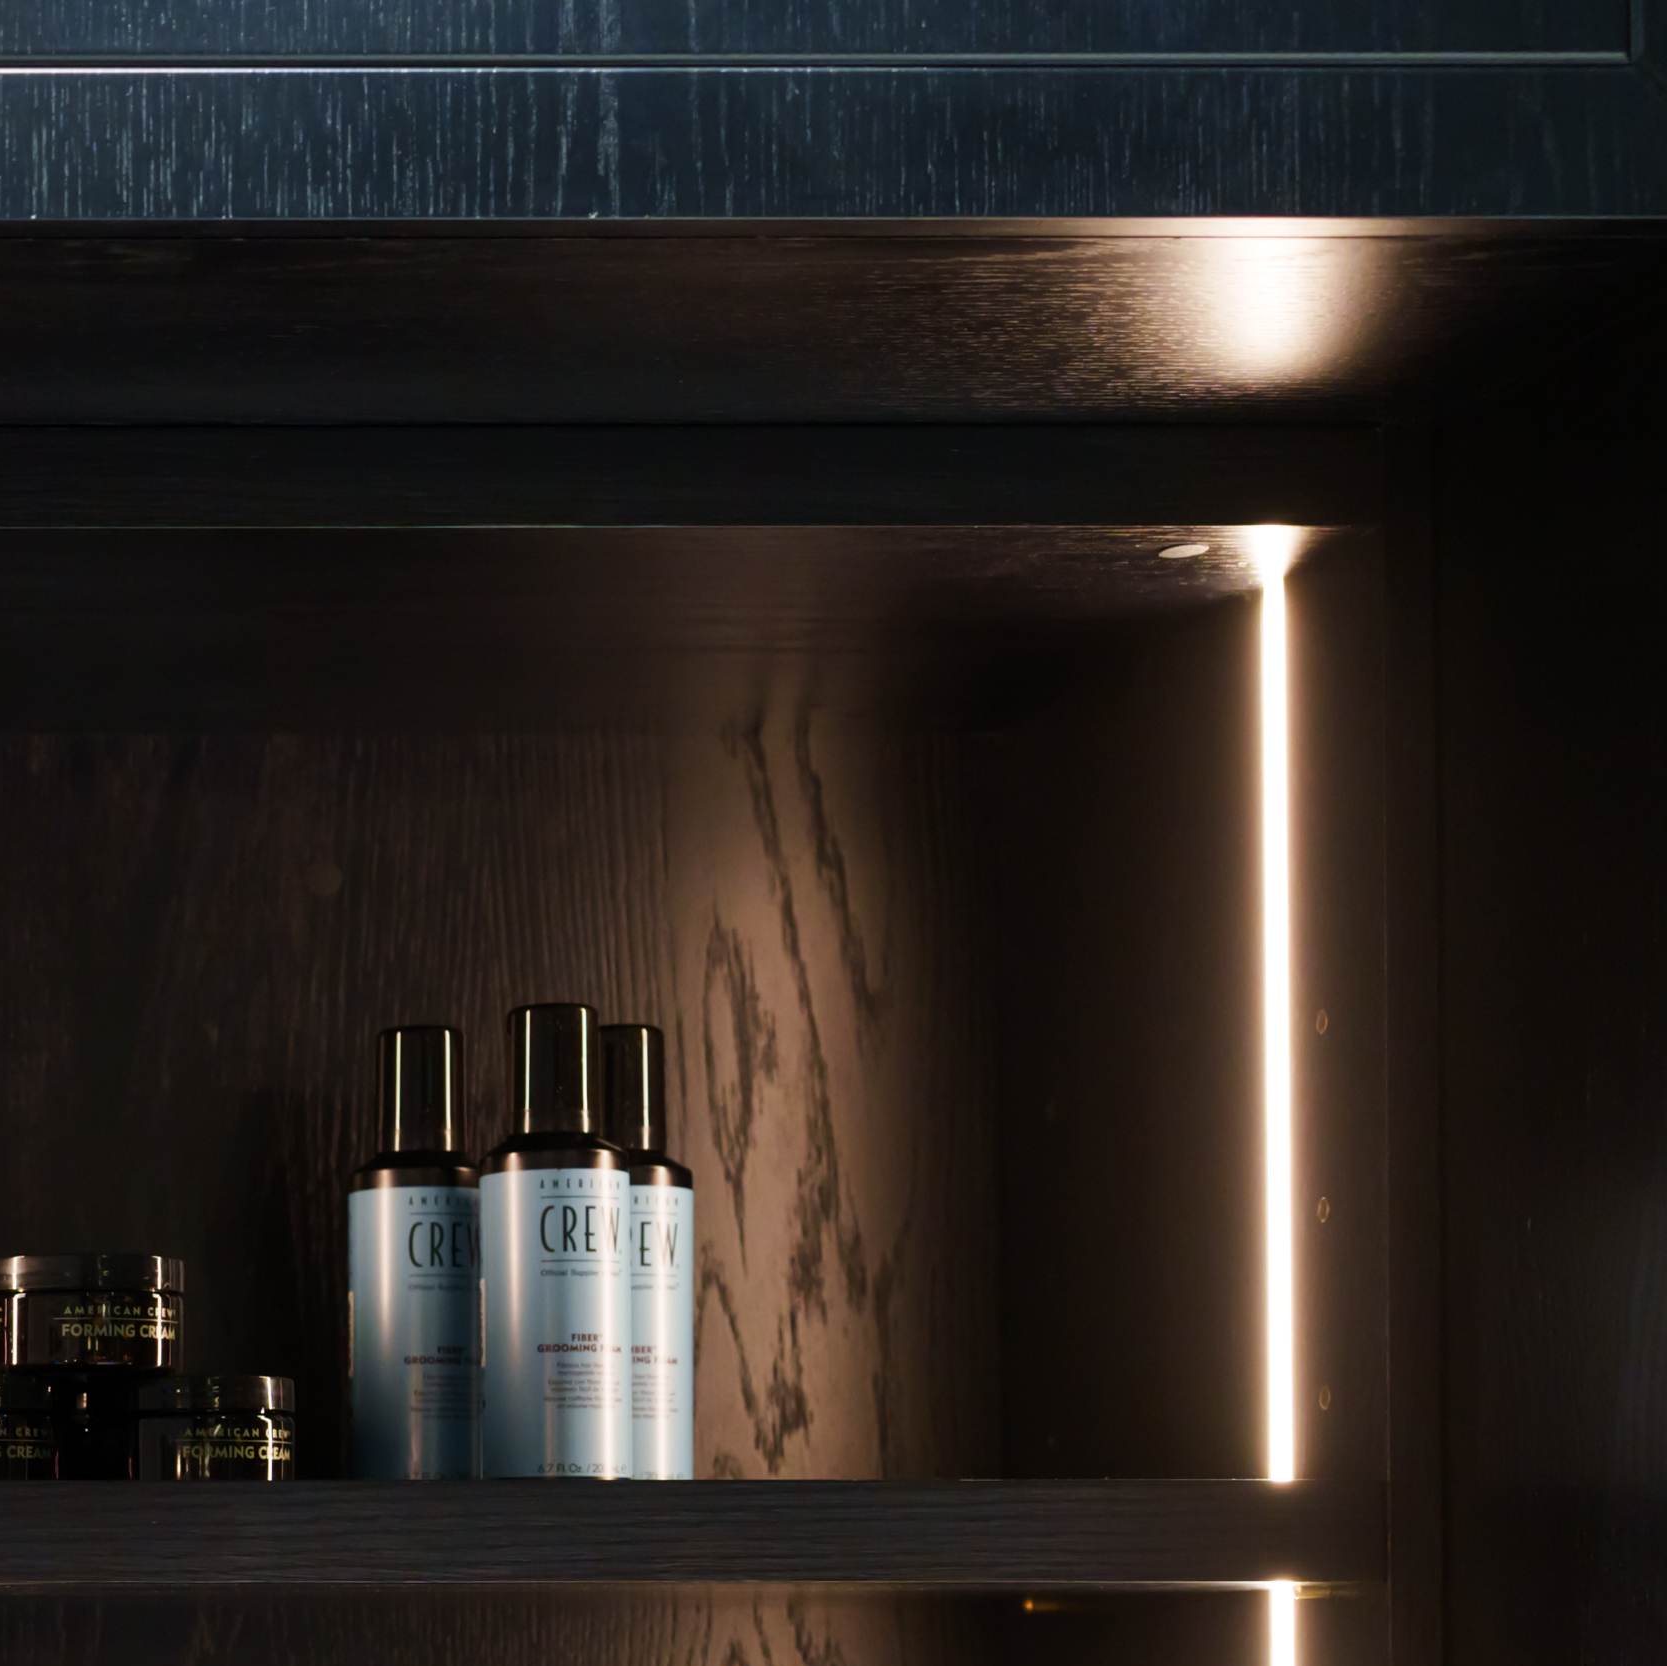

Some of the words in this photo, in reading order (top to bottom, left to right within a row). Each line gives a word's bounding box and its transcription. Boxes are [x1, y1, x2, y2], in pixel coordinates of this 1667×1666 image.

[539, 1205, 620, 1253] CREW
[62, 1324, 136, 1338] FORMING
[537, 1344, 598, 1353] GROOMING
[7, 1446, 52, 1459] CREAM
